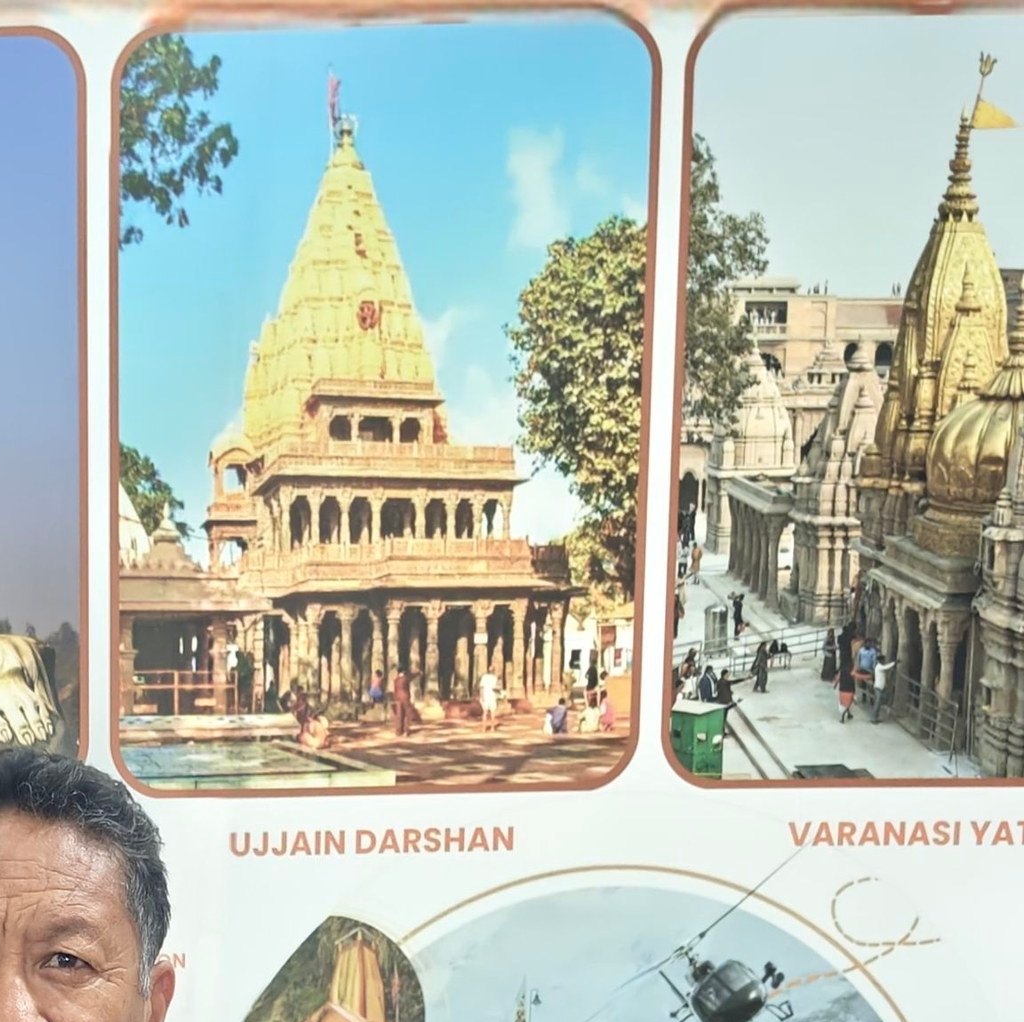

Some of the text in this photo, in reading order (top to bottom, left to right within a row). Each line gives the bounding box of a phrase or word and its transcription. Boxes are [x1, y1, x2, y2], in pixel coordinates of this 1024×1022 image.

[229, 826, 514, 857] UJJAIN DARSHAN
[790, 821, 961, 847] VARANASI
